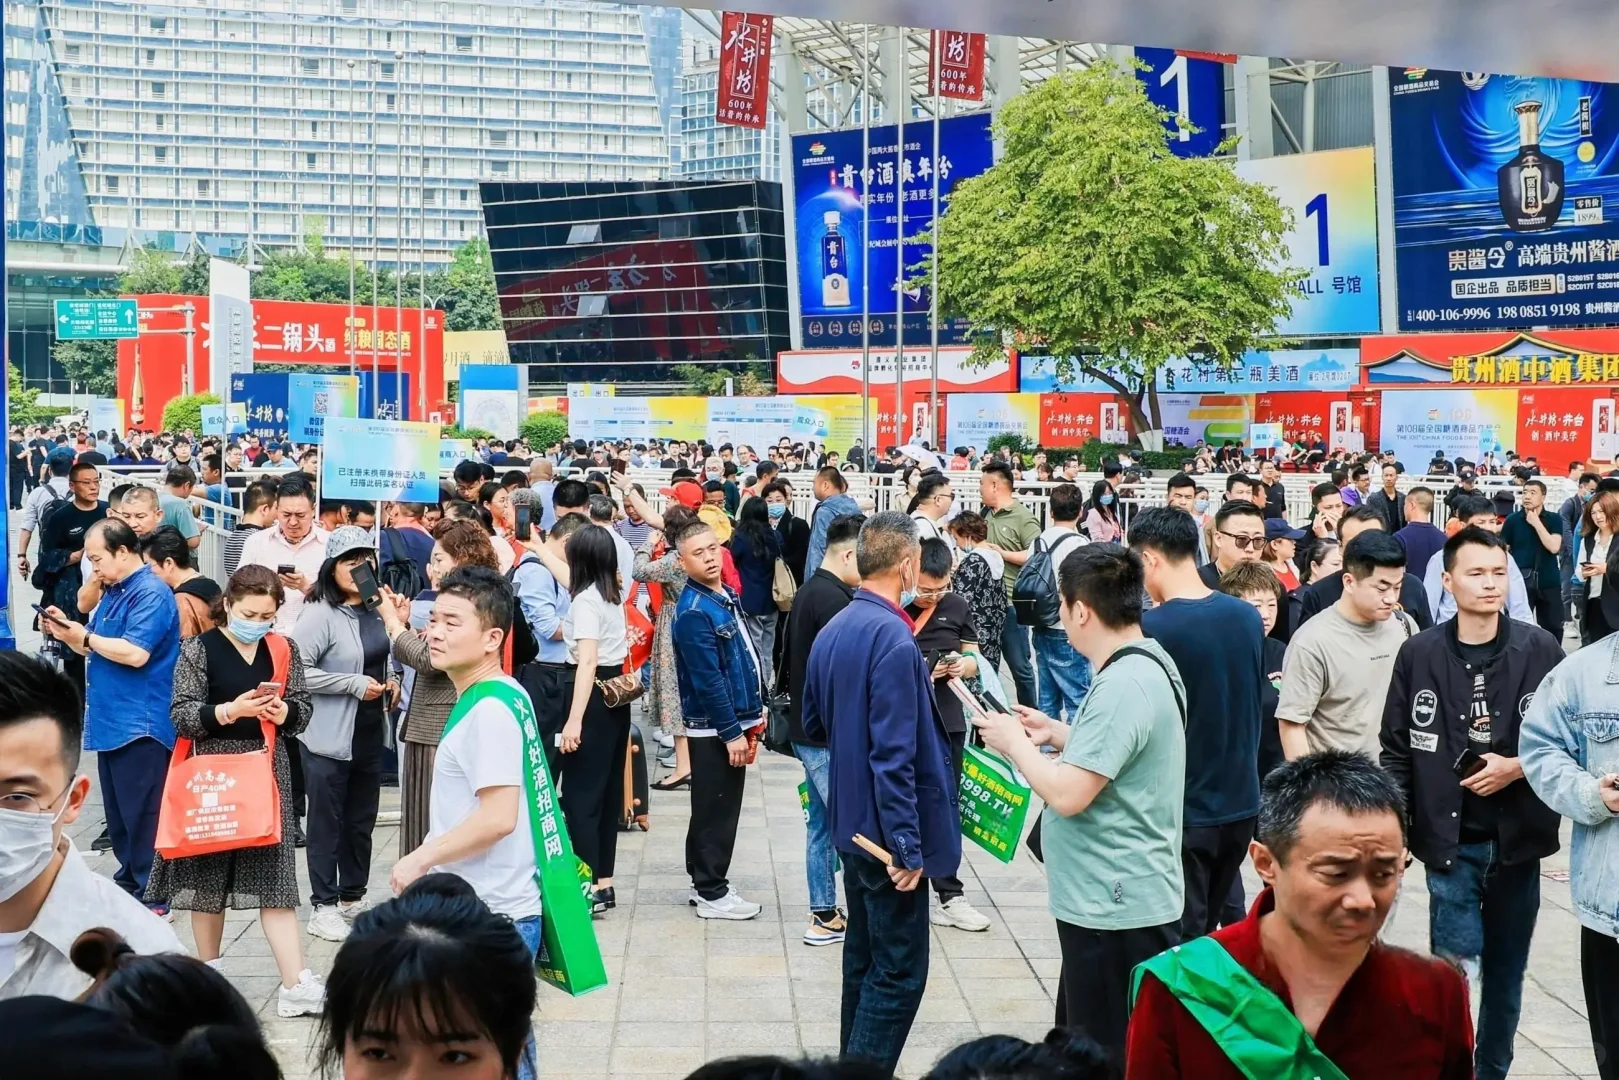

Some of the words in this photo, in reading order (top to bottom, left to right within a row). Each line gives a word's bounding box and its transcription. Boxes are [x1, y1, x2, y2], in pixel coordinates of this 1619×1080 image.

[725, 12, 756, 93] 水井坊
[941, 68, 967, 81] 600年
[728, 99, 752, 111] 600年
[719, 109, 760, 123] 活着的传承
[886, 215, 909, 223] 展位址
[1305, 193, 1329, 266] 1
[1332, 275, 1361, 294] 号馆
[1456, 281, 1500, 296] 国企出品
[1506, 276, 1551, 293] 品质担当
[1415, 307, 1490, 322] 400-106-9996
[1498, 306, 1517, 319] 198
[1520, 305, 1548, 318] 0851
[1550, 303, 1580, 317] 9198
[1162, 426, 1190, 435] 国糖酒会
[350, 478, 414, 489] 扫描此码实名认证
[513, 697, 563, 861] 火爆好酒招商网
